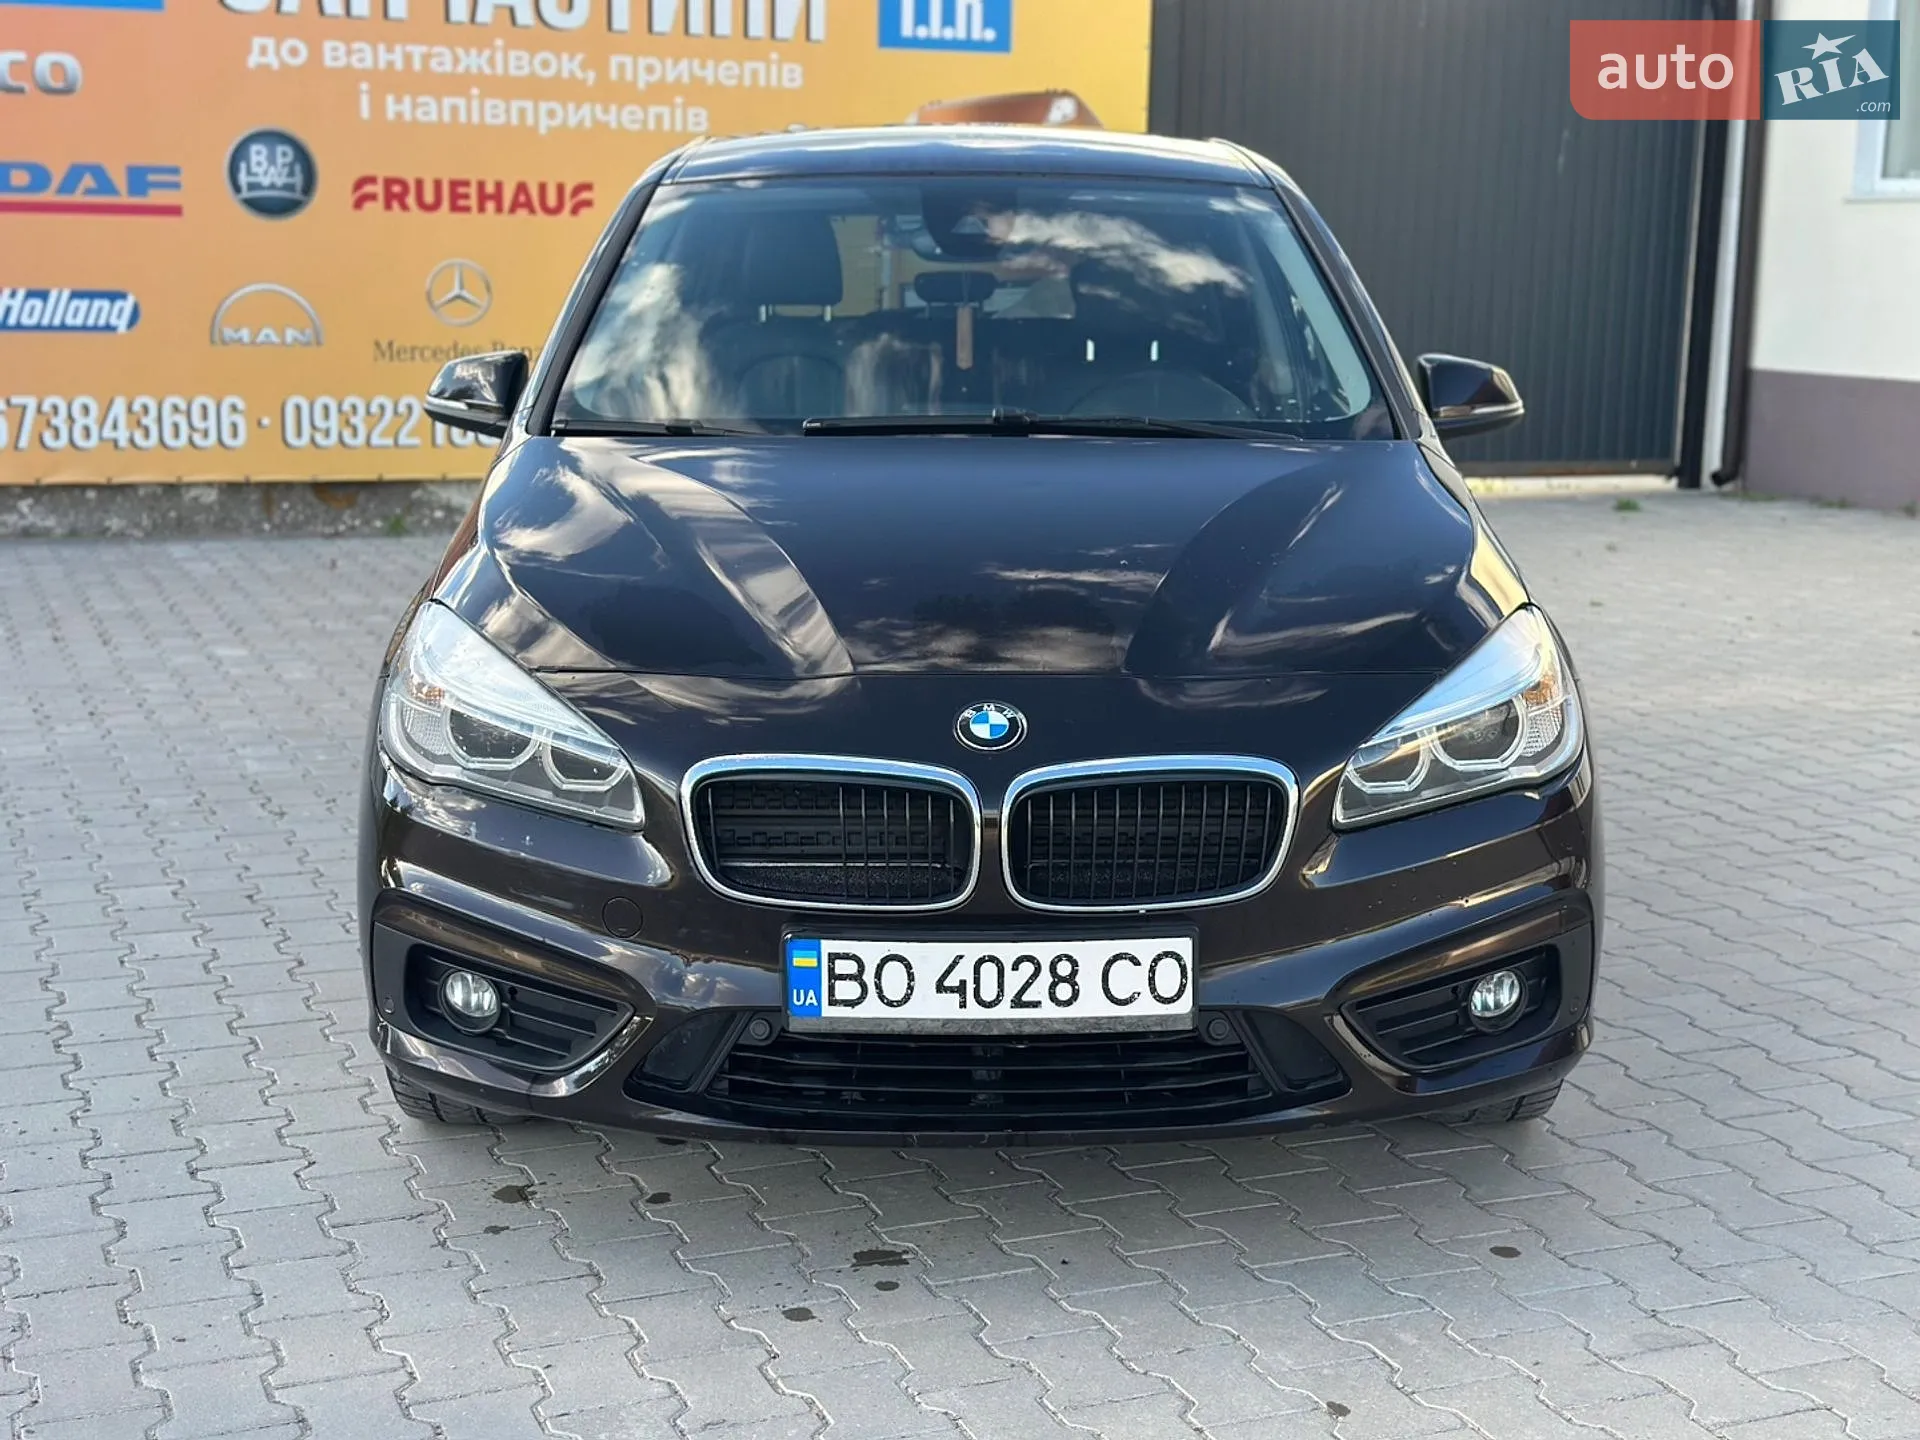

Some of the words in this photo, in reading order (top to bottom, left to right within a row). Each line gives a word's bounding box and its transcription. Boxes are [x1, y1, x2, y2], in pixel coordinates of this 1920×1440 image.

[247, 36, 308, 69] до
[322, 38, 596, 85] вантажівок,
[609, 52, 803, 90] причепів
[386, 87, 709, 135] напівпричепів
[0, 161, 182, 197] DAF
[352, 174, 595, 217] FRUEHAUF
[220, 326, 315, 345] MAN
[962, 702, 1016, 719] BMW
[793, 989, 818, 1006] UA
[827, 952, 916, 1009] BO
[935, 953, 1081, 1010] 4028
[1101, 950, 1189, 1008] CO
